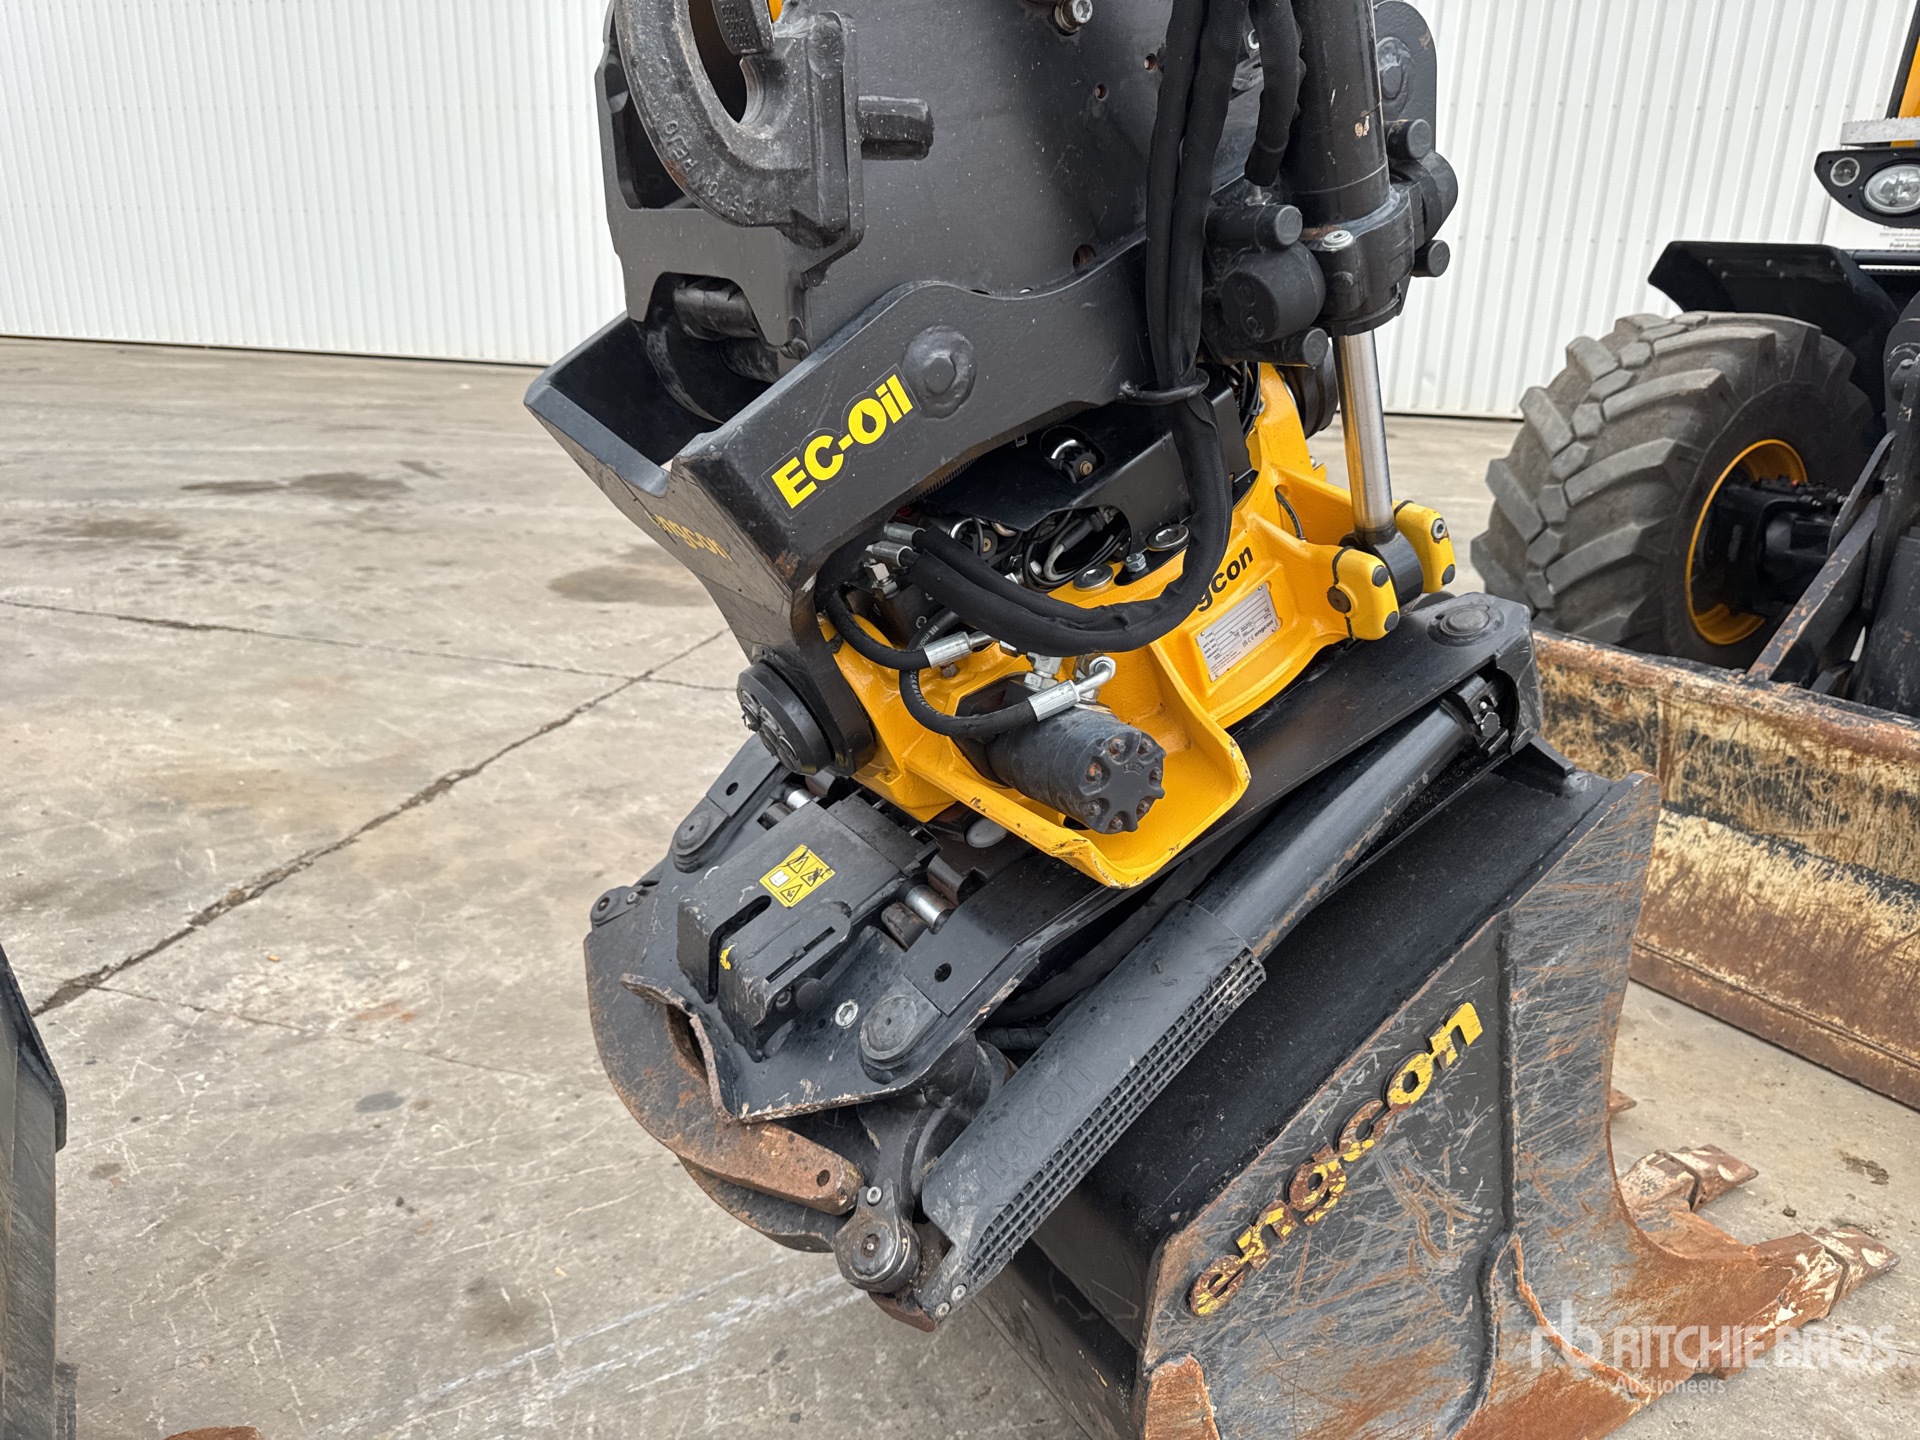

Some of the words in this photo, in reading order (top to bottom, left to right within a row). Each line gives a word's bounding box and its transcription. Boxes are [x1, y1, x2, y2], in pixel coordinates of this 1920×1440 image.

[772, 375, 915, 510] EC-Oil
[1198, 546, 1254, 612] gcon
[1190, 1001, 1483, 1316] engcon
